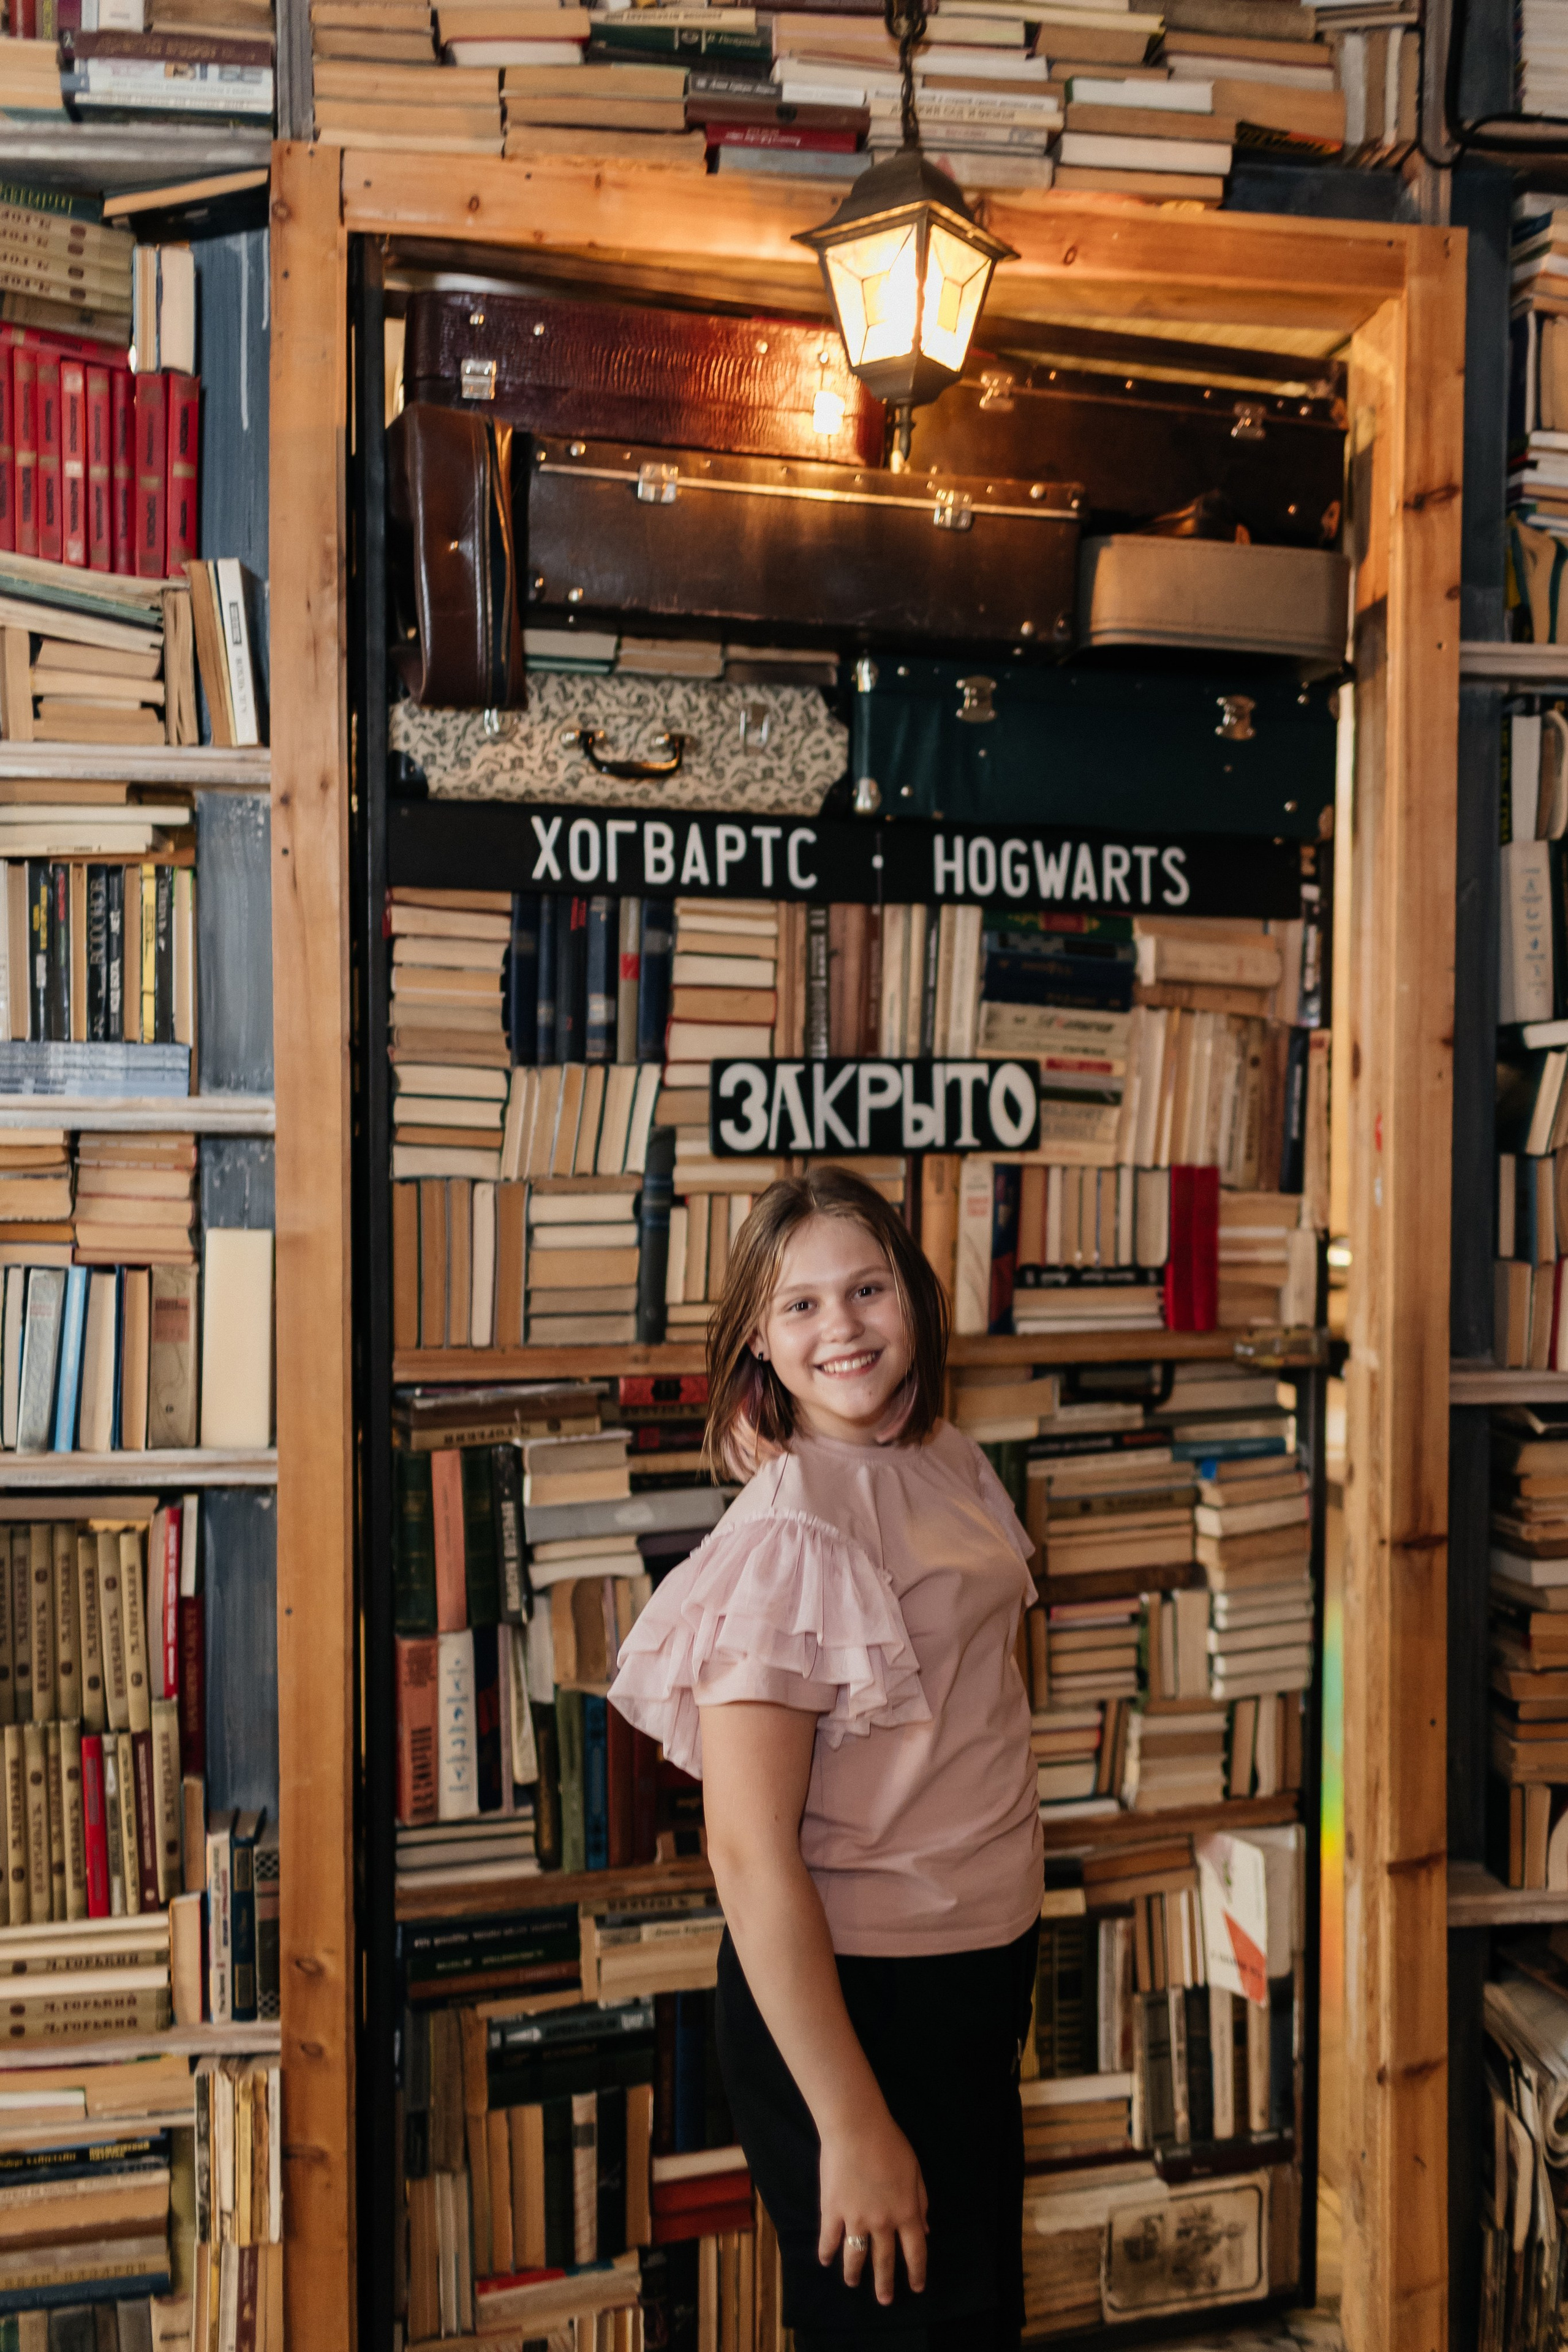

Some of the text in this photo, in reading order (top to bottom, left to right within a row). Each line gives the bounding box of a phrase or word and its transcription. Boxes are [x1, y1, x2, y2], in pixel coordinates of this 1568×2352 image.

[531, 816, 817, 889] ХОГВАРТС
[933, 834, 1189, 906] HOGWARTS
[719, 1063, 1036, 1152] ЗАКРЫТО
